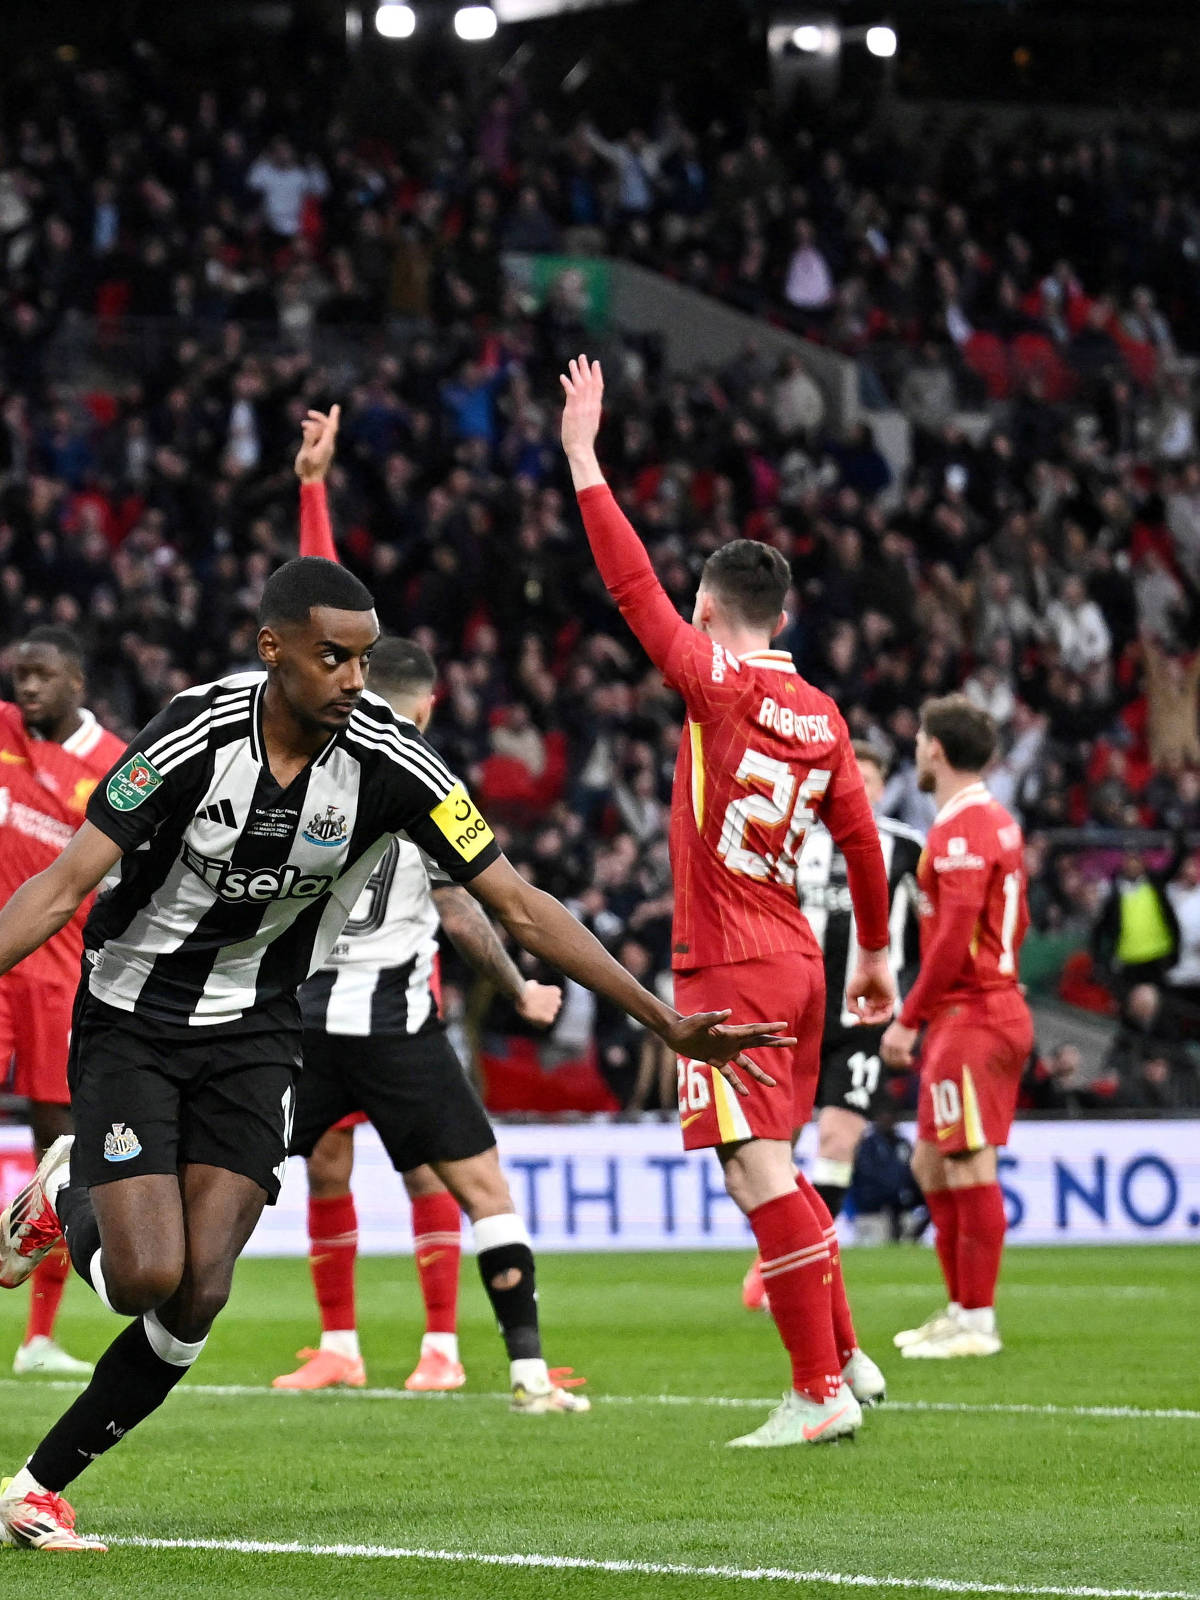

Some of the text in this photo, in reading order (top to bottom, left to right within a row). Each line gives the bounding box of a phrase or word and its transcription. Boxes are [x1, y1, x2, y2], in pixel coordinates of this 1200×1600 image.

[118, 784, 133, 797] Cup
[221, 869, 327, 899] sela
[847, 1051, 881, 1094] 11
[930, 1079, 961, 1126] 10
